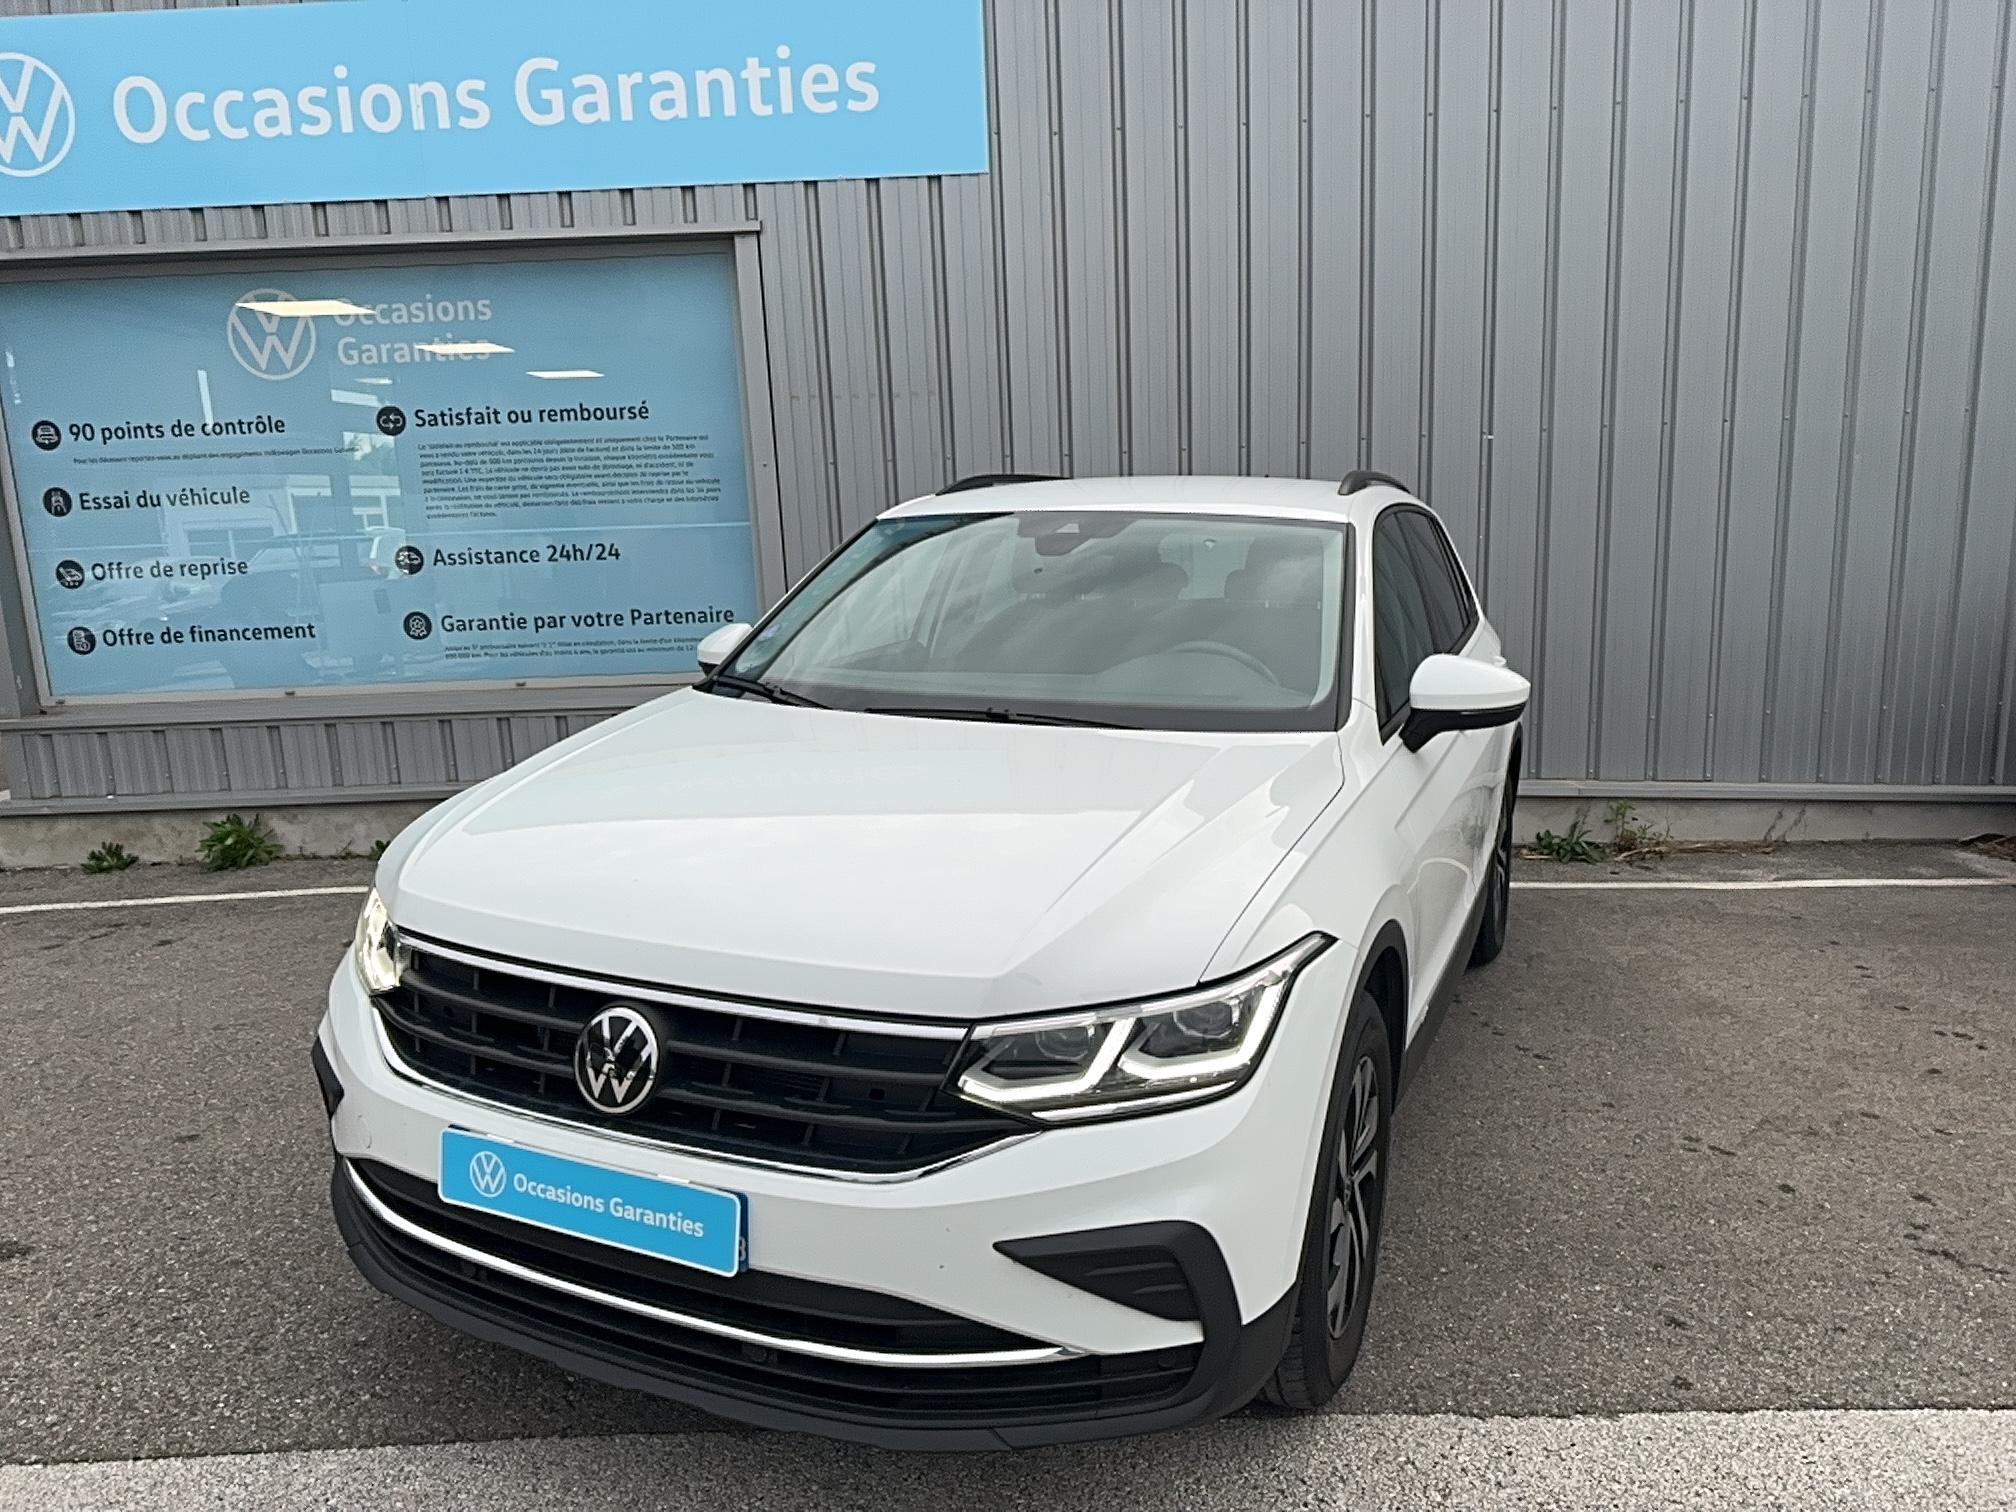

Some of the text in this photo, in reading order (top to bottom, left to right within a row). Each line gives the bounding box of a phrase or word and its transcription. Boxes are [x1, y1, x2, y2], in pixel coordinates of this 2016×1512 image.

[113, 65, 490, 145] Occasions
[514, 45, 881, 127] Garanties
[414, 400, 650, 429] Satisfait ou remboursé
[68, 415, 286, 445] 90 points de contrôle
[79, 485, 251, 511] Essai du véhicule
[90, 556, 249, 581] Offre de reprise
[432, 543, 621, 567] Assistance 24h/24
[102, 621, 316, 647] Offre de financement
[440, 605, 735, 634] Garantie par votre Partenaire
[512, 1172, 605, 1213] Occasions
[609, 1196, 704, 1238] Garanties
